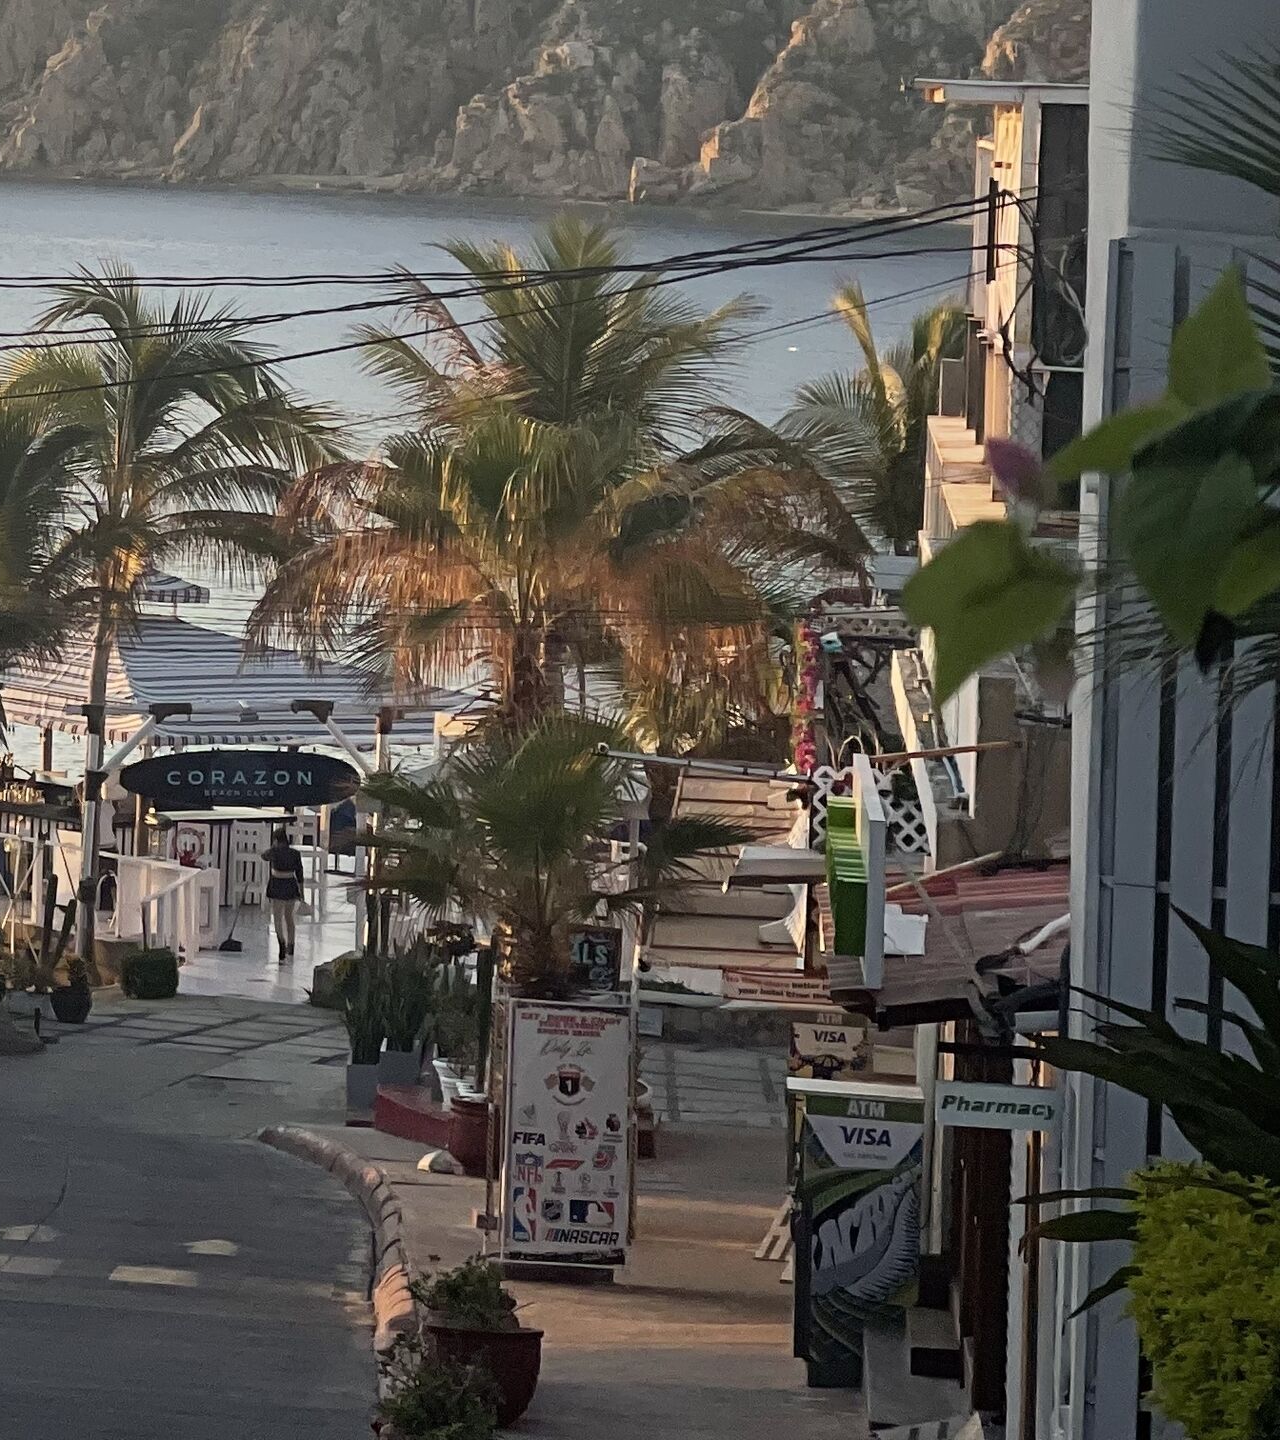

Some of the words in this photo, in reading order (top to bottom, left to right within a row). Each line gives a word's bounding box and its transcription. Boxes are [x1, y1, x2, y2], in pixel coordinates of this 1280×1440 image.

[166, 769, 314, 786] CORAZON
[204, 789, 241, 797] BEACH
[246, 789, 274, 797] CLUB
[816, 1012, 843, 1025] ATM
[813, 1029, 847, 1044] VISA
[846, 1099, 886, 1119] ATM
[941, 1094, 1055, 1120] Pharmacy
[513, 1131, 546, 1146] FIFA
[838, 1125, 892, 1148] VISA
[516, 1166, 543, 1184] NFL
[558, 1228, 620, 1246] NASCAR
